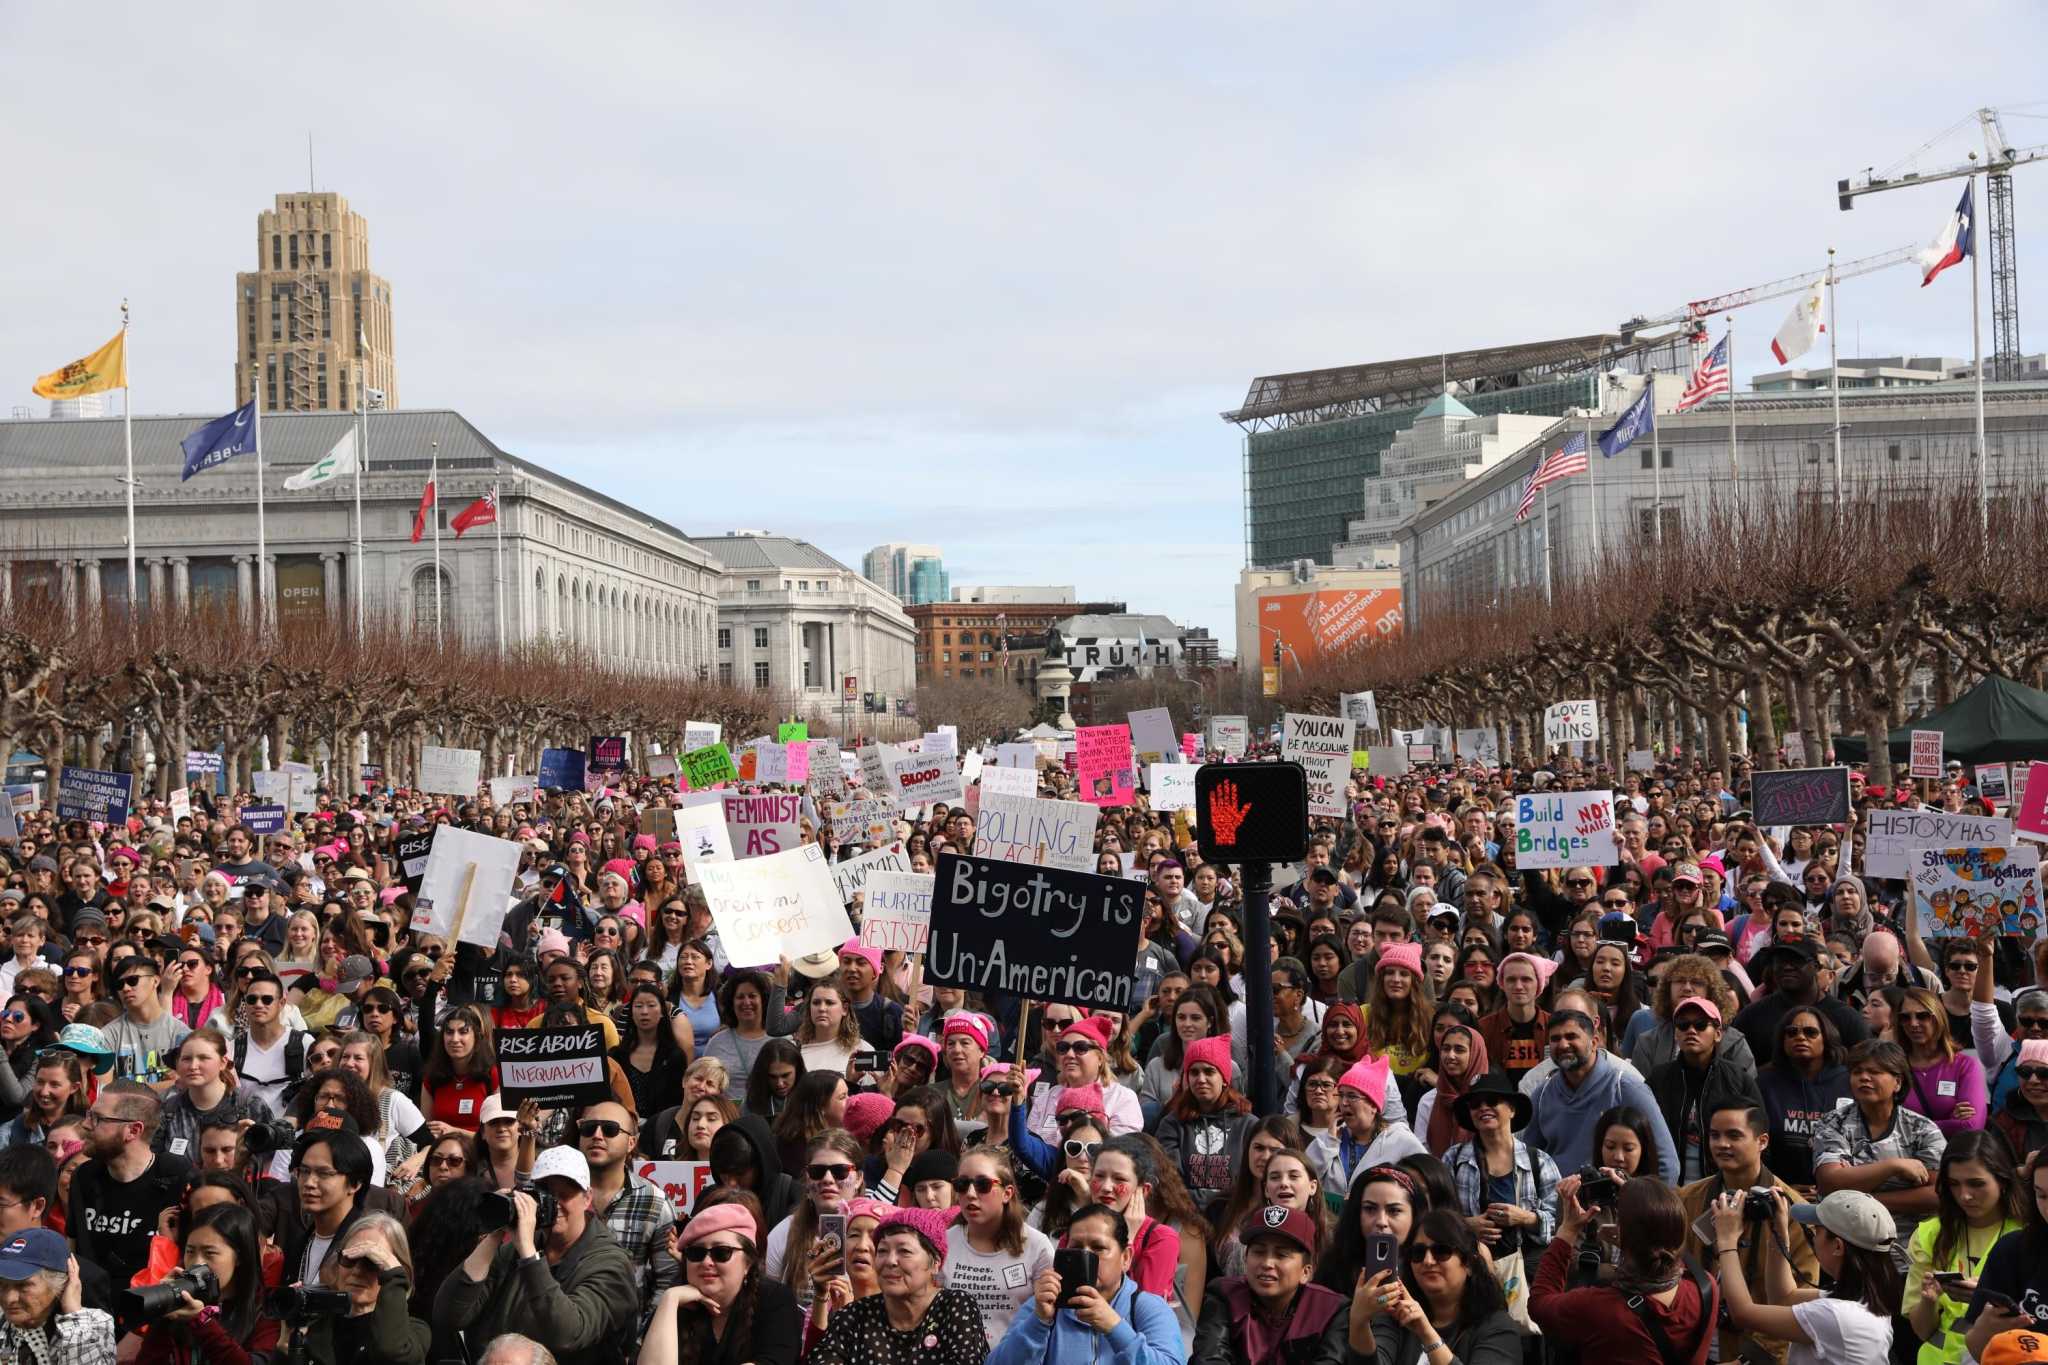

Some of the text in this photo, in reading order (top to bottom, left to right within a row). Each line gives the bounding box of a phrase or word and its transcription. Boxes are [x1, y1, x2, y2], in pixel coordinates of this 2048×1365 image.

[283, 587, 320, 598] OPEN
[1320, 591, 1358, 625] DAZZLES
[1324, 588, 1383, 637] TRANSFORMS
[1327, 616, 1368, 652] THROUGH
[1552, 704, 1591, 718] LOVE
[1293, 718, 1344, 738] YOU CAN
[1547, 722, 1593, 741] WINS
[1287, 738, 1349, 753] BE MASCULINE
[1914, 742, 1940, 754] HURTS
[1292, 755, 1334, 768] WITHOUT
[1913, 755, 1940, 766] WOMEN
[68, 769, 93, 780] SCIENCE
[101, 774, 117, 785] REAL
[900, 769, 941, 787] BLOOD
[100, 785, 127, 798] MATTER
[1307, 782, 1335, 795] XIC
[110, 796, 123, 807] ARE
[725, 796, 799, 825] FEMINIST
[1519, 797, 1564, 823] Build
[91, 812, 108, 822] LOVE
[242, 811, 283, 819] PERSISTENTLY
[977, 810, 1077, 855] POLLING
[1869, 813, 1996, 841] HISTORY HAS
[400, 837, 429, 856] RISE
[747, 829, 781, 855] AS
[1517, 828, 1590, 859] Bridges
[1868, 838, 1905, 856] ITS
[1922, 851, 1988, 872] Stronger
[1980, 864, 2035, 887] Together
[872, 891, 932, 912] HURRI
[951, 860, 1133, 938] Bigotry is
[861, 919, 929, 951] RESISTA
[929, 930, 1132, 1006] Un-American
[499, 1030, 599, 1054] RISE ABOVE
[511, 1062, 594, 1083] INEQUALITY
[85, 1207, 144, 1234] Resis
[952, 1271, 996, 1281] friends.
[955, 1262, 994, 1273] heroes.
[951, 1282, 1001, 1291] mothers.
[978, 1302, 1014, 1311] naries.
[2017, 1335, 2040, 1353] SF
